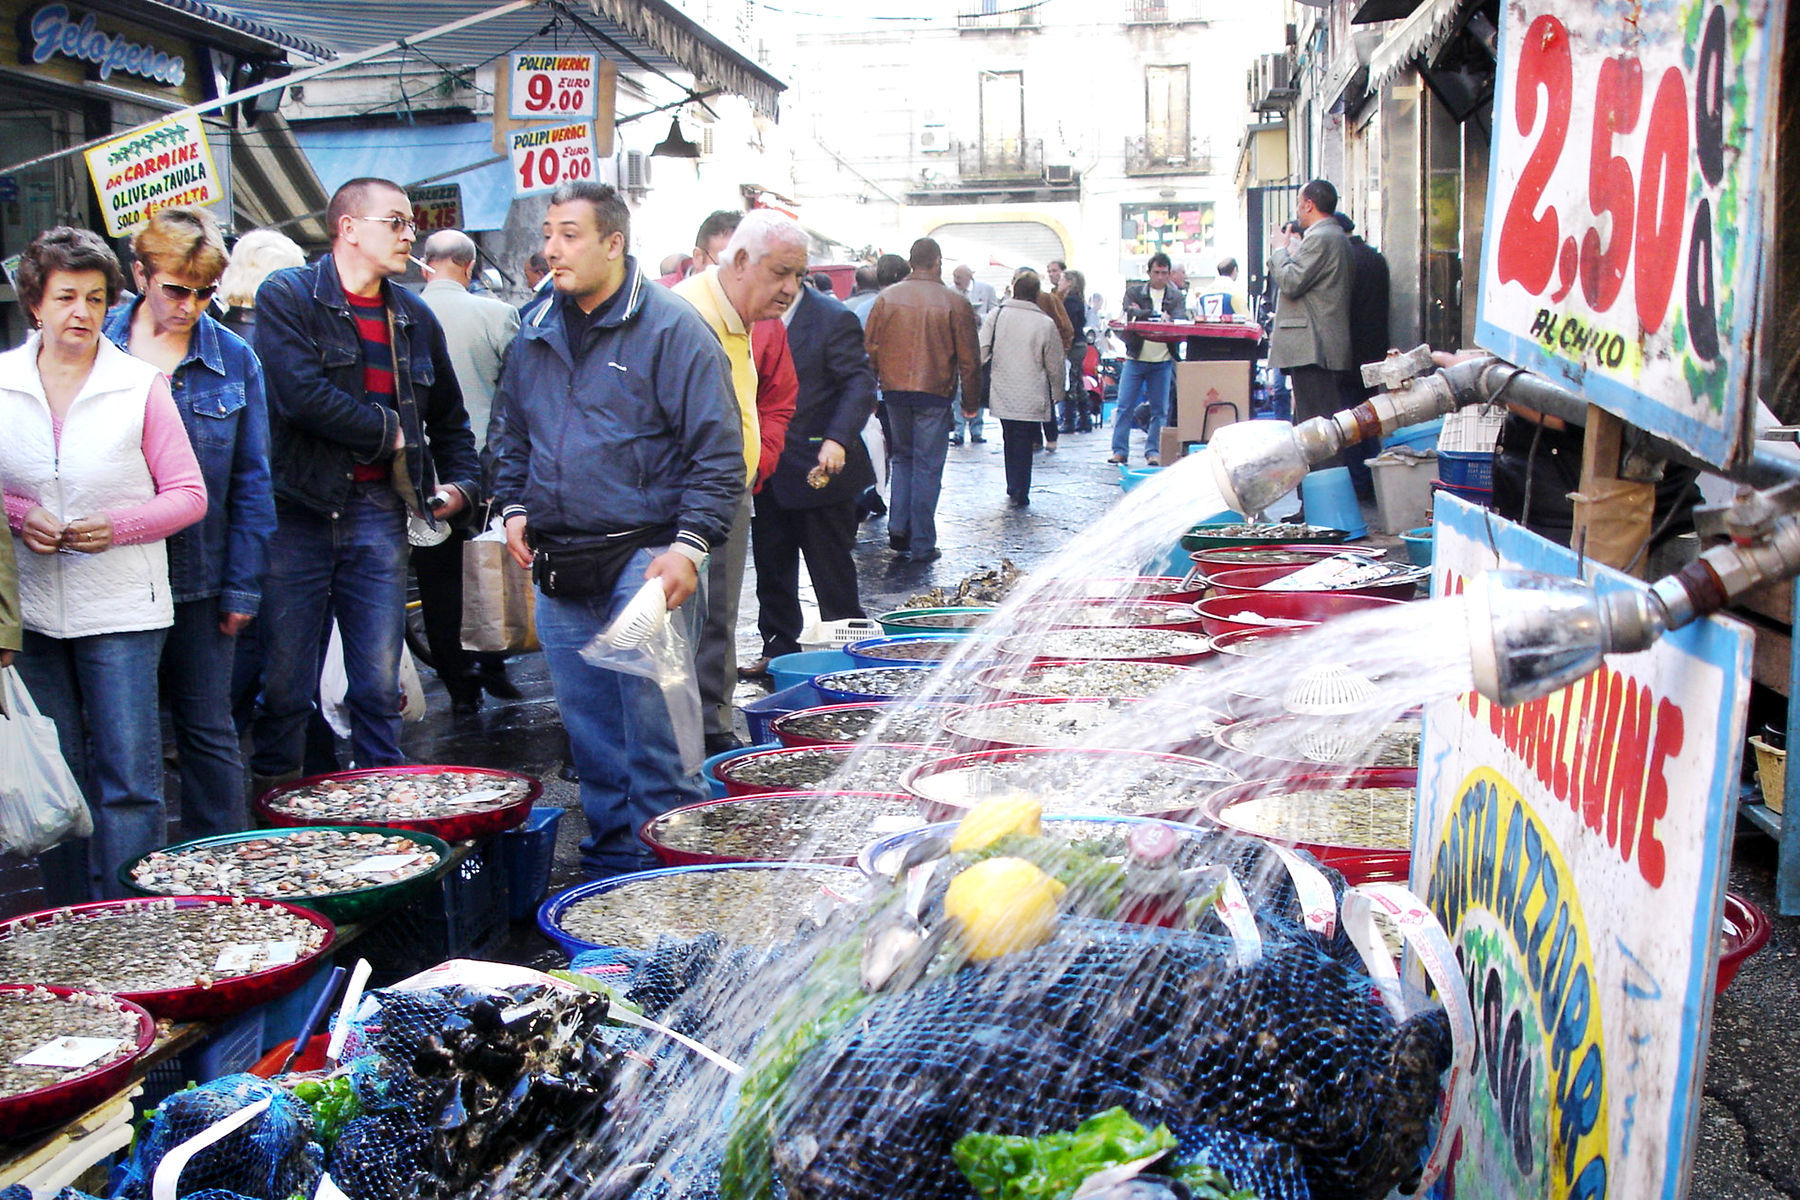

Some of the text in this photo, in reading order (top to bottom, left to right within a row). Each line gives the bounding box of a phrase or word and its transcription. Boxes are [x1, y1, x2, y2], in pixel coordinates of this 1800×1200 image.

[517, 56, 590, 72] POLIPI VERACI
[558, 77, 590, 88] EURO
[513, 124, 587, 150] POLIPI VERACI
[123, 142, 199, 182] CARMINE
[562, 146, 589, 158] EURO
[112, 183, 148, 211] OLIVE
[162, 162, 206, 192] TAVOLA
[116, 210, 140, 230] SOLO
[1207, 300, 1219, 315] 7
[1530, 308, 1558, 345] AL
